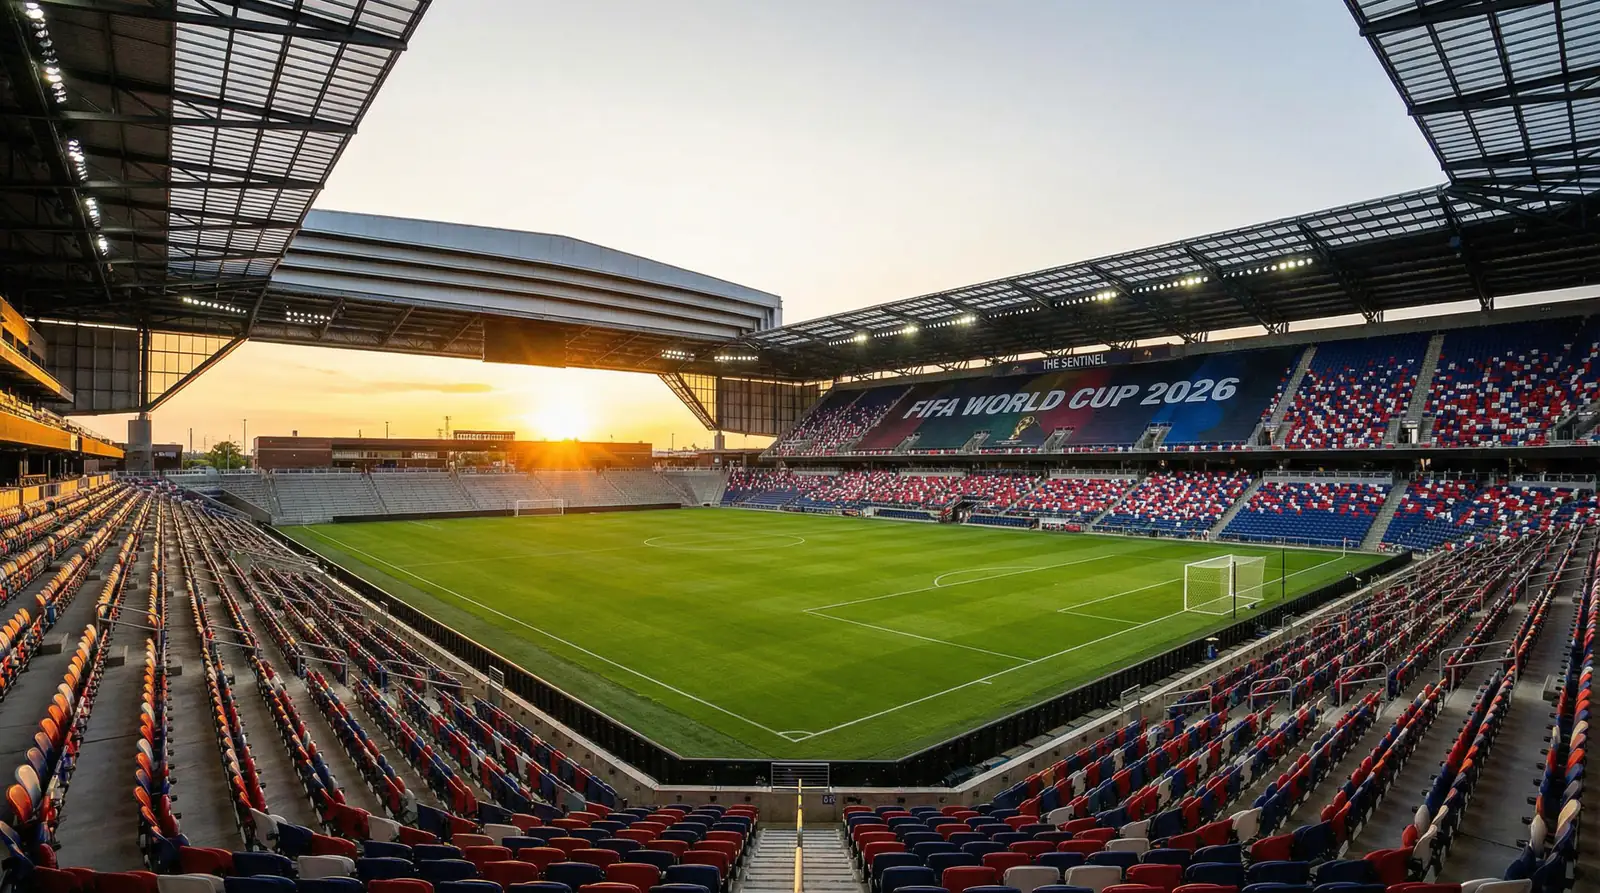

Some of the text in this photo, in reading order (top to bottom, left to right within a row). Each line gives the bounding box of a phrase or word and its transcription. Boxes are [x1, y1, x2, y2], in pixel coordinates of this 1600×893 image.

[1043, 353, 1107, 370] THE SENTINEL
[902, 377, 1240, 419] FIFA WORLD CUP 2026
